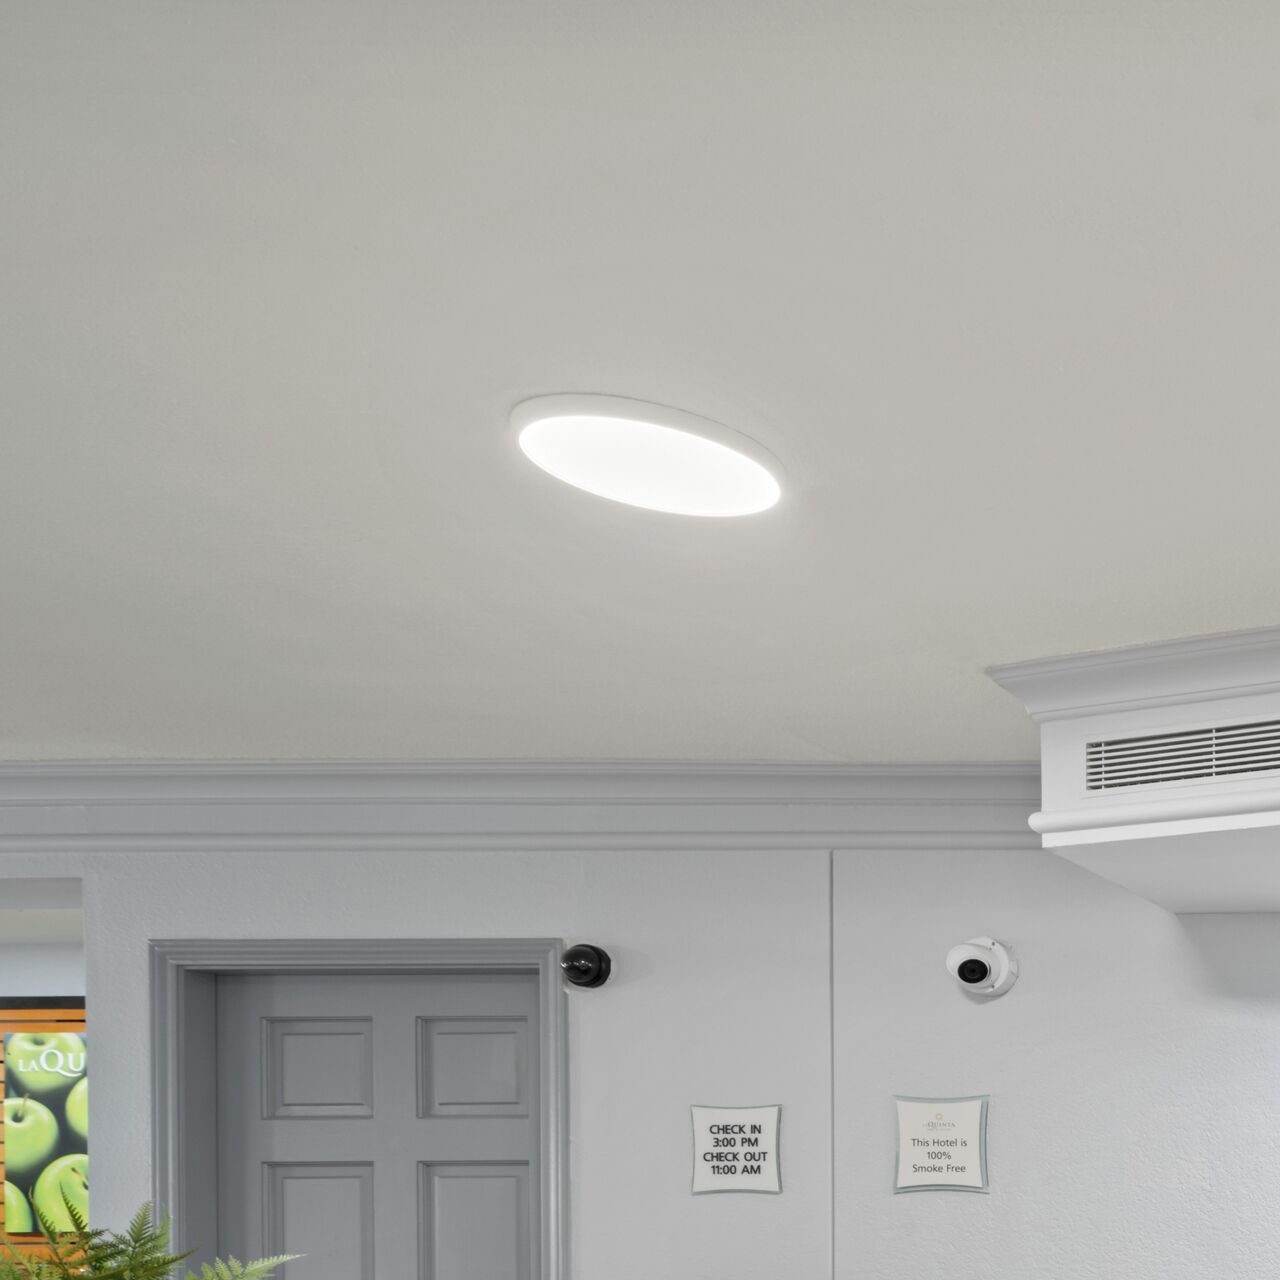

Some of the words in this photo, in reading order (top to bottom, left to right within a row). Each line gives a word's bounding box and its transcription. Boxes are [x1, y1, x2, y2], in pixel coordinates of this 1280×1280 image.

[709, 1124, 746, 1134] CHECK
[750, 1124, 762, 1134] IN
[712, 1137, 736, 1148] 3:00
[741, 1137, 758, 1147] PM
[911, 1138, 930, 1147] This
[932, 1138, 958, 1147] Hotel
[960, 1138, 968, 1147] is
[703, 1152, 740, 1162] CHECK
[744, 1152, 768, 1162] OUT
[927, 1151, 952, 1160] 100%
[711, 1165, 737, 1175] 11:00
[741, 1165, 761, 1175] AM
[912, 1164, 944, 1173] Smoke
[946, 1164, 966, 1173] Free
